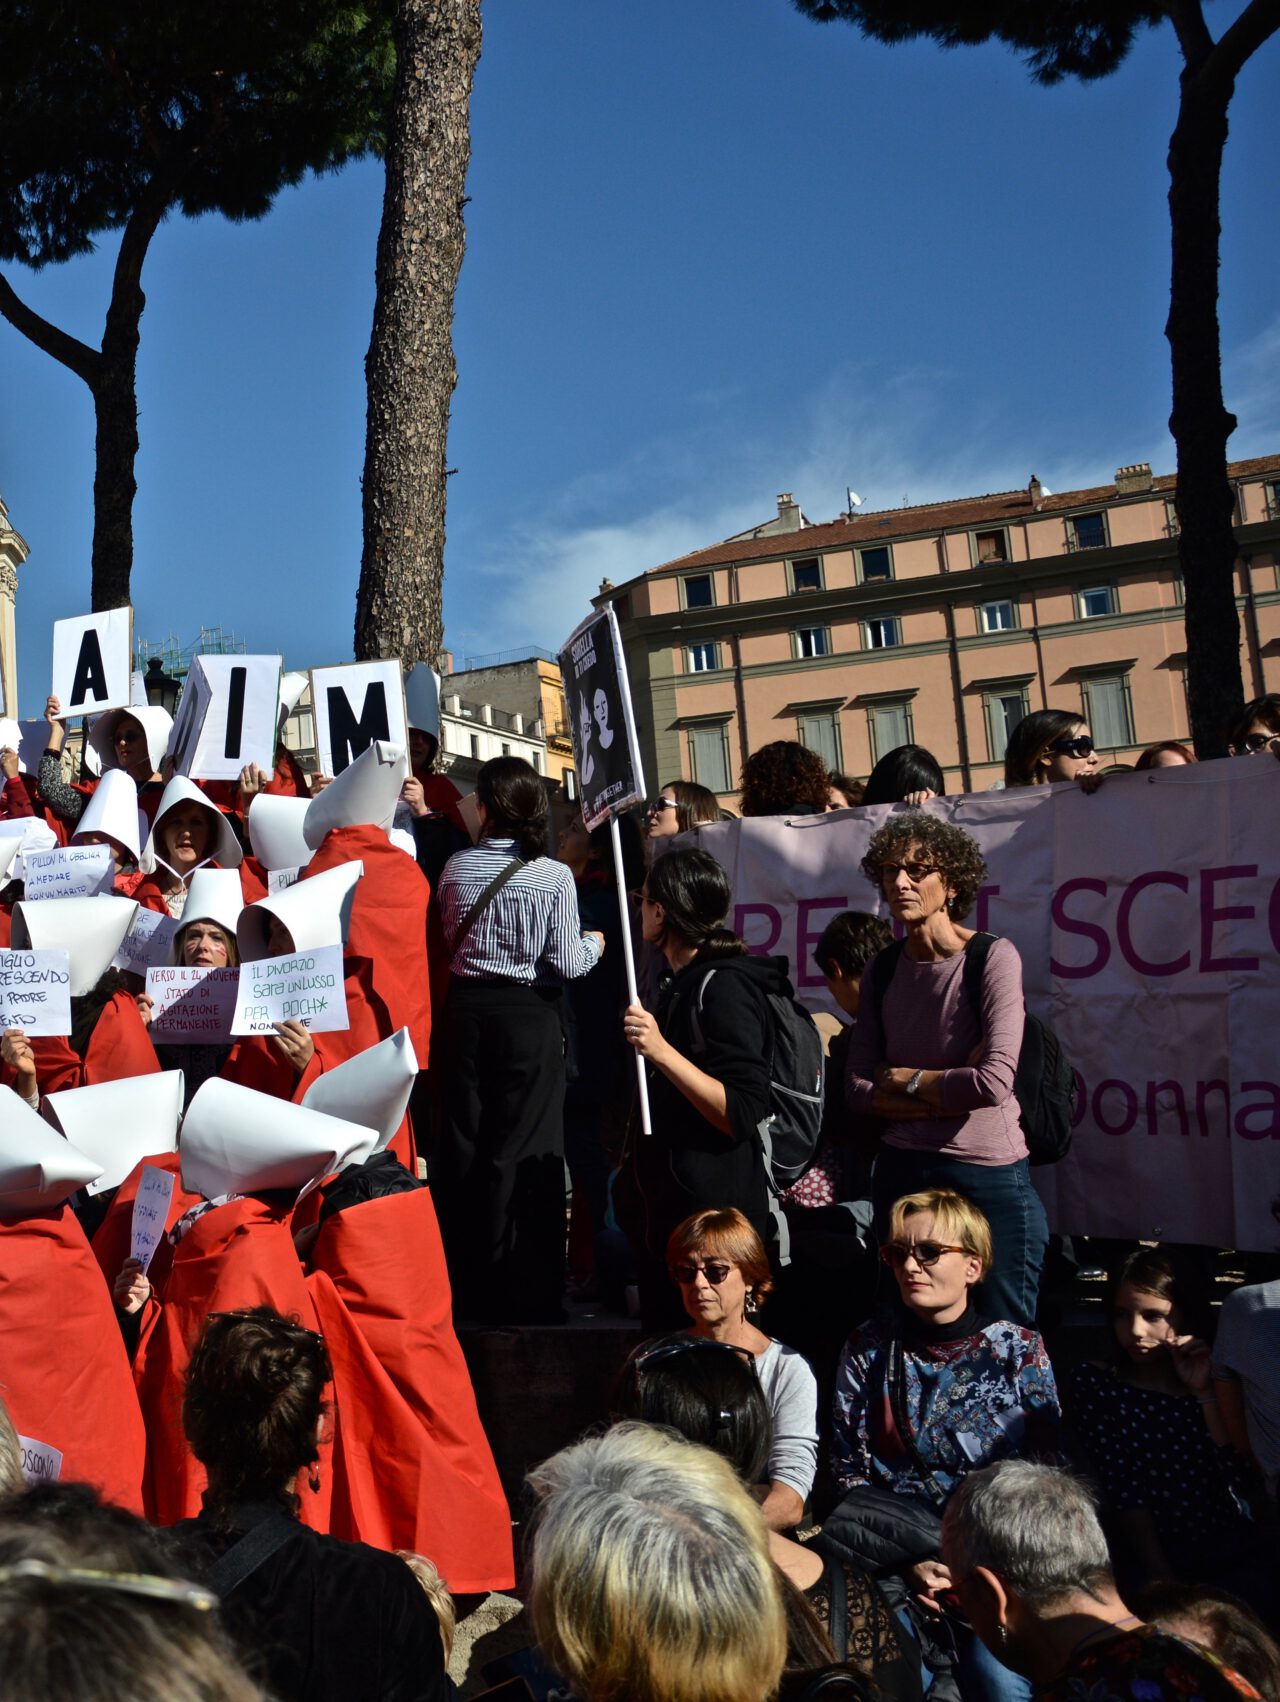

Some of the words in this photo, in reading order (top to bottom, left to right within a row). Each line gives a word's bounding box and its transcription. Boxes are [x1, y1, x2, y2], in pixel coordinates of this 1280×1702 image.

[70, 628, 109, 707] A
[225, 666, 247, 759] I
[326, 681, 391, 777] M
[31, 854, 56, 869] PILLON
[58, 853, 67, 863] MI
[36, 872, 71, 885] MEDIARE
[56, 885, 87, 897] MARITO
[1049, 863, 1280, 980] SCE
[266, 957, 315, 978] DIVORZIO
[150, 970, 176, 983] VERSO
[180, 971, 187, 981] IL
[191, 969, 202, 981] 24
[6, 991, 48, 1006] PADRE
[164, 988, 193, 999] STATO
[200, 988, 210, 998] DI
[159, 1004, 220, 1017] AGITAZIONE
[244, 1005, 270, 1021] PER
[156, 1019, 221, 1031] PERMANENTE
[250, 1022, 275, 1031] NON
